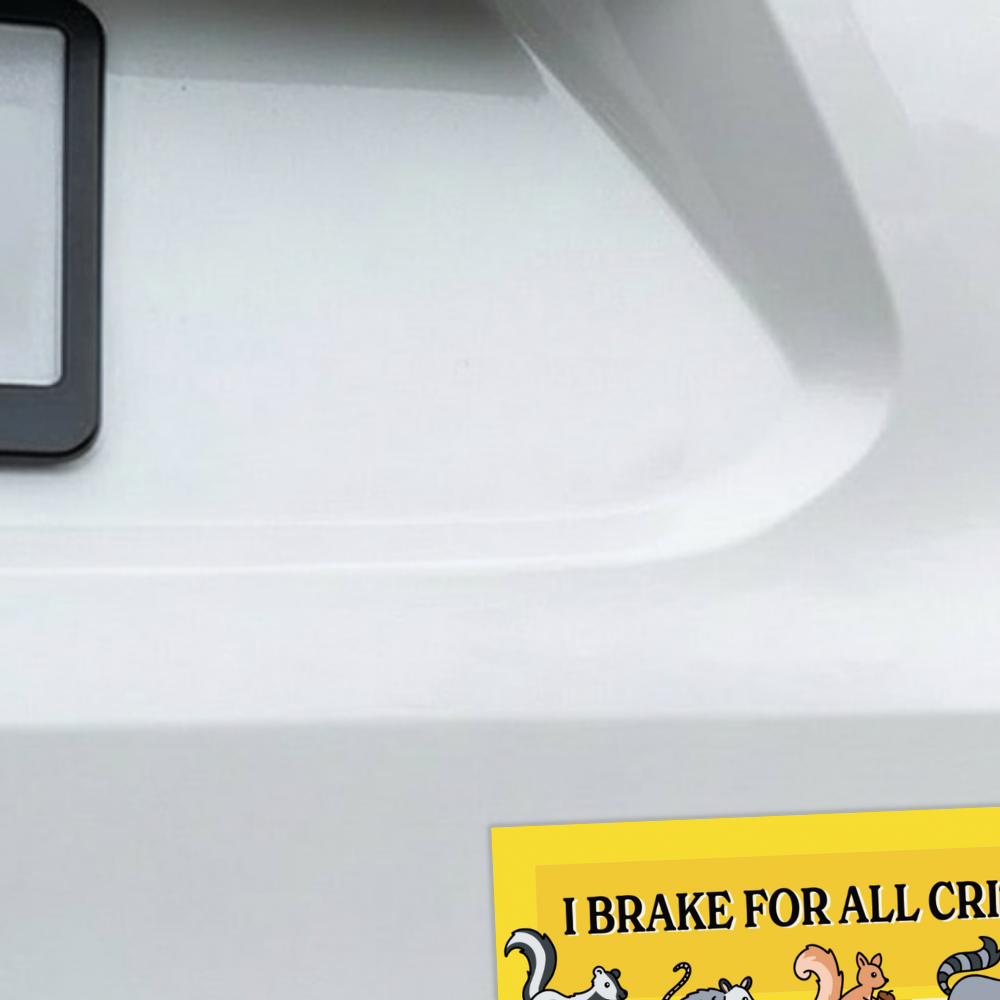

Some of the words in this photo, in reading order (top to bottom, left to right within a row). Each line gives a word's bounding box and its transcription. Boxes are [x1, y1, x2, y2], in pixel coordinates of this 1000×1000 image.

[563, 897, 578, 936] I
[587, 889, 734, 935] BRAKE
[743, 887, 831, 929] FOR
[838, 881, 922, 925] ALL
